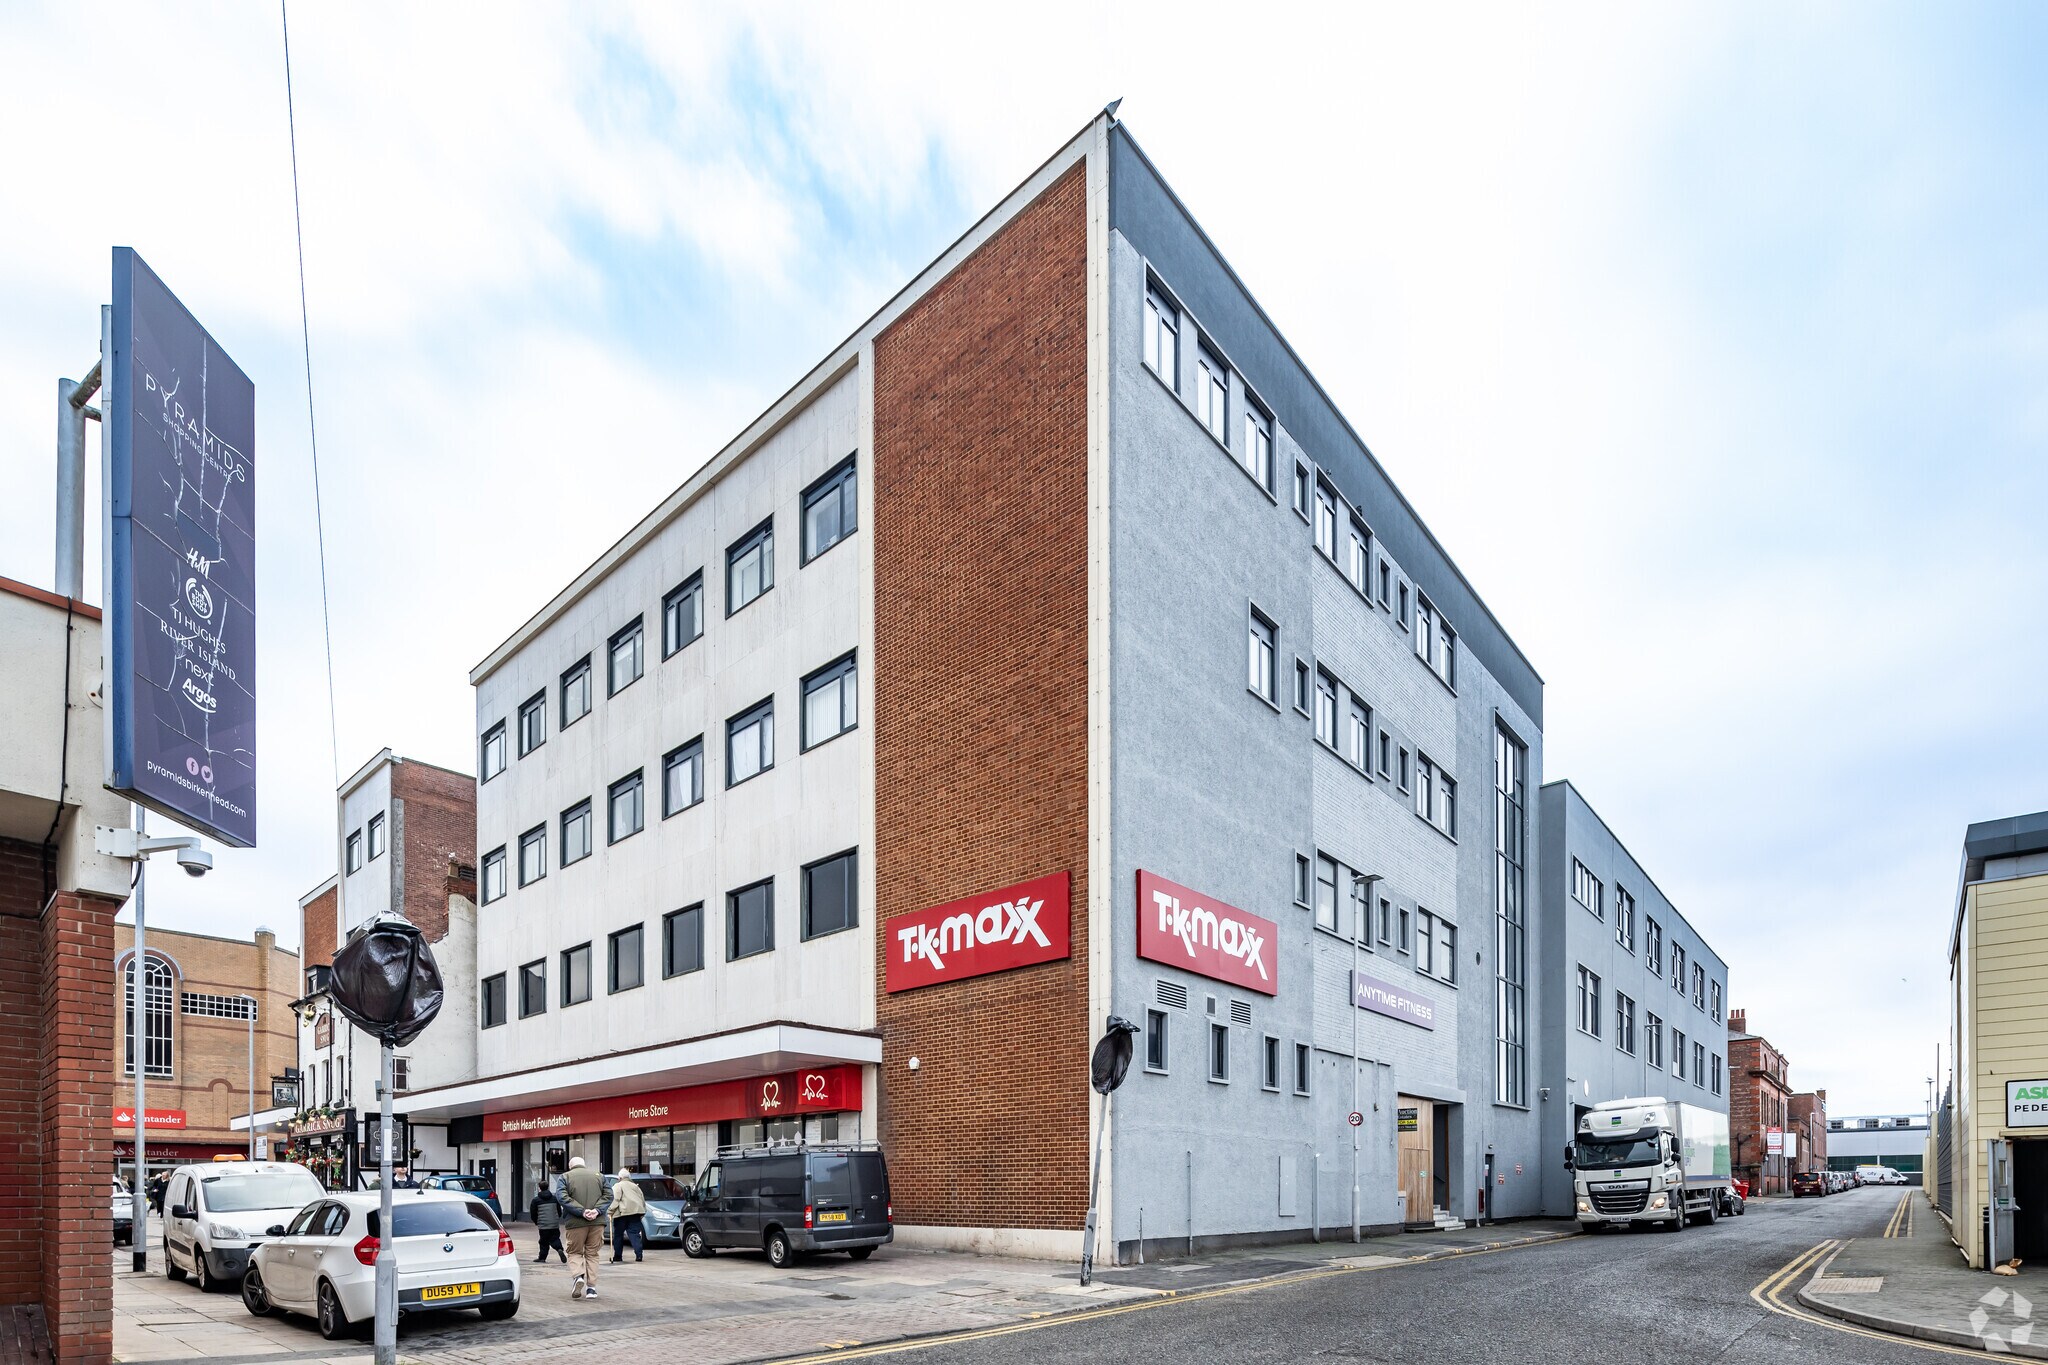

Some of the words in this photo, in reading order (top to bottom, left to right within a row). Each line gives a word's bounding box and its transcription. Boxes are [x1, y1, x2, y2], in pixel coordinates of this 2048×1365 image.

[146, 374, 245, 483] PYRAMIDS
[163, 412, 202, 455] SHOPPING
[205, 453, 232, 484] CENTRE
[186, 547, 211, 579] H&M
[172, 606, 182, 624] TJ
[184, 615, 226, 654] HUGHES
[160, 619, 195, 654] RIVER
[198, 645, 236, 680] ISLAND
[185, 658, 215, 687] next
[182, 678, 217, 709] Argos
[147, 760, 247, 818] pyramidsbirkenhead.com
[1357, 983, 1397, 1008] ANYTIME
[1397, 997, 1432, 1020] FITNESS
[317, 1023, 331, 1035] GARRIC
[132, 1113, 181, 1124] Sntander
[502, 1119, 520, 1132] British
[520, 1118, 536, 1130] Heart
[537, 1114, 571, 1129] Foundation
[628, 1107, 649, 1119] Home
[650, 1104, 669, 1117] Store
[128, 1148, 179, 1157] Stander
[426, 1286, 454, 1298] DU59
[456, 1284, 476, 1294] YJL
